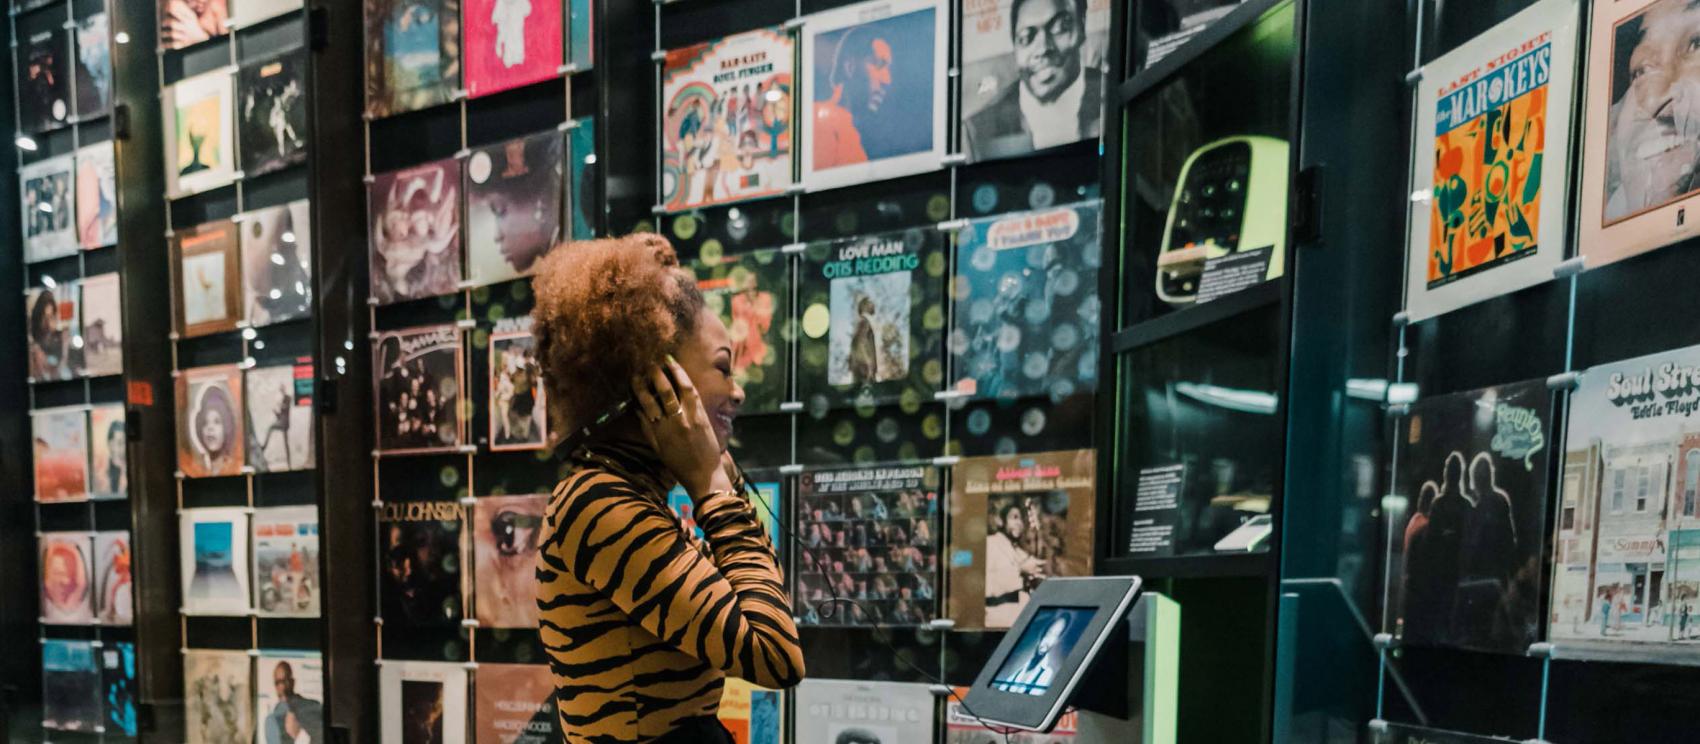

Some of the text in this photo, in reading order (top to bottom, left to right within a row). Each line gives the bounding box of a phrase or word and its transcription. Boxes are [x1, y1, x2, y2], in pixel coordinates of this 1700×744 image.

[739, 63, 773, 79] FINGER
[1437, 66, 1481, 97] LAST
[839, 240, 904, 261] LOVE MAN
[823, 260, 852, 279] OTIS
[1606, 367, 1655, 408] Soul
[1631, 396, 1700, 419] Eddie Floyd
